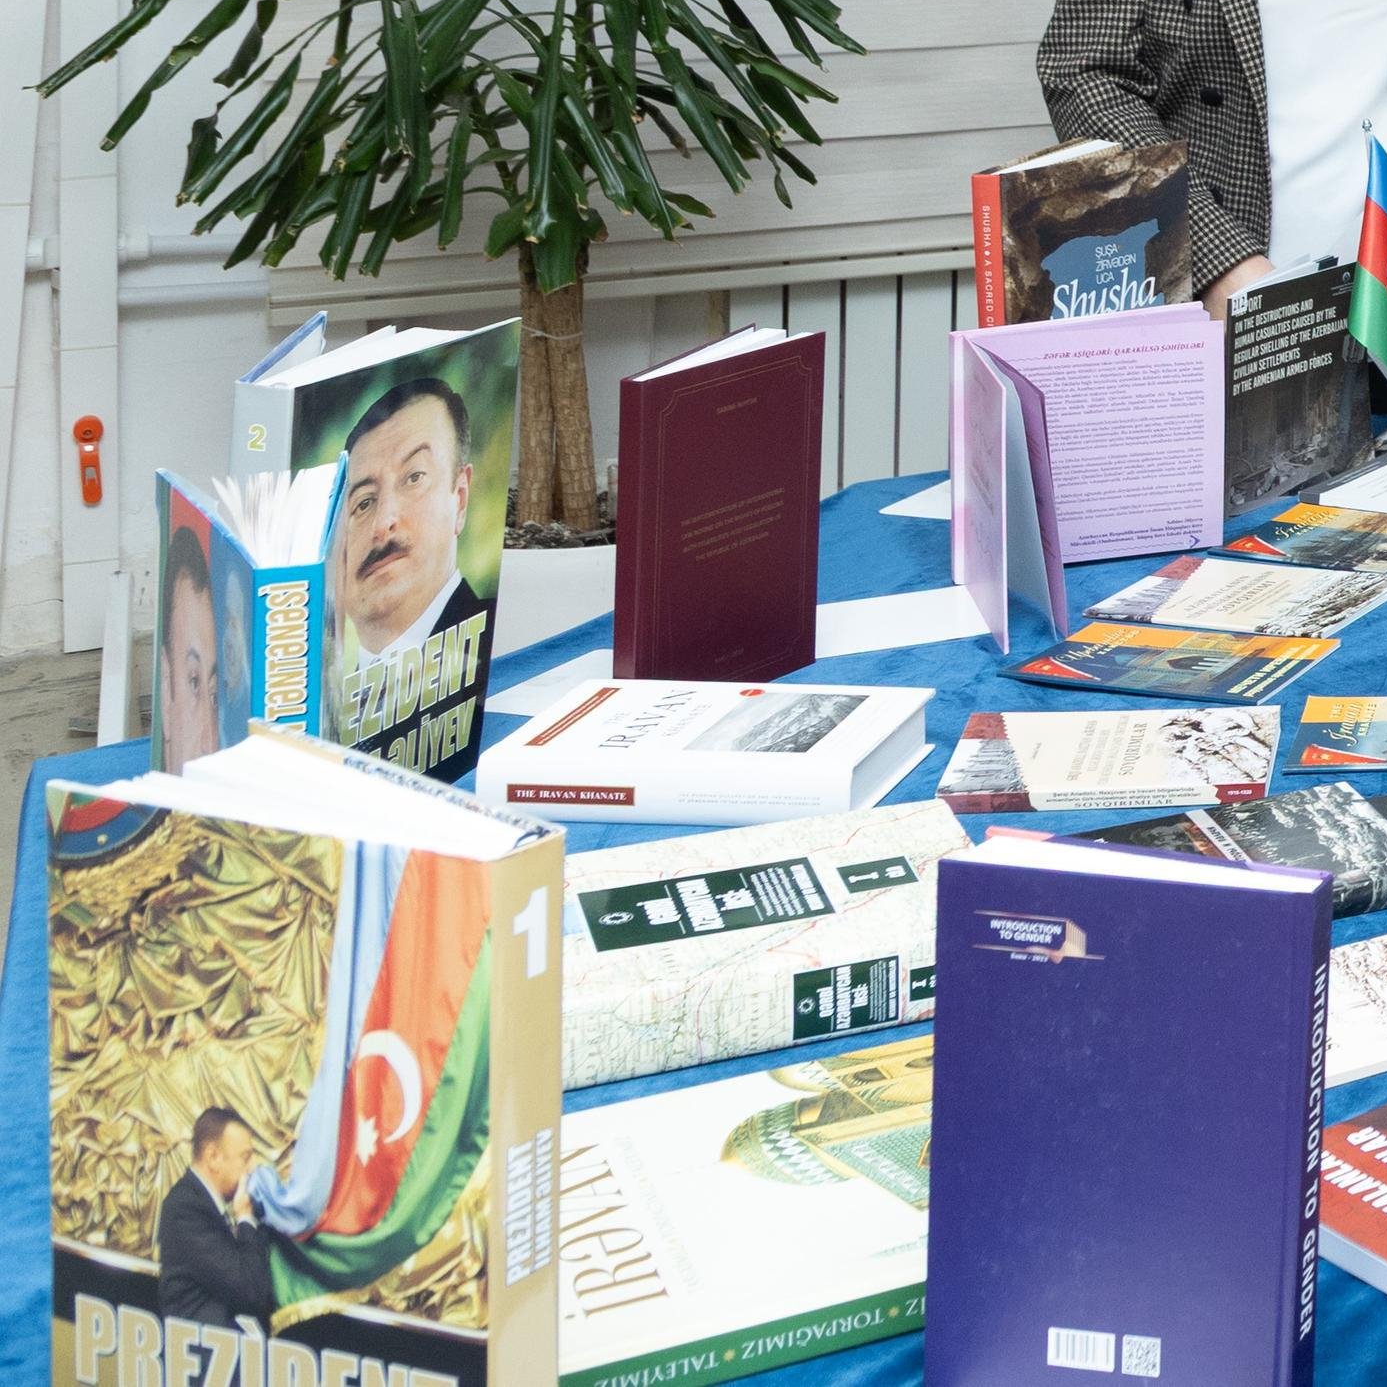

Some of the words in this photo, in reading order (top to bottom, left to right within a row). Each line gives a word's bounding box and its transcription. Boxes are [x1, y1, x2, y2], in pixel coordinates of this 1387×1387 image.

[982, 205, 992, 249] SHUSHA
[984, 270, 994, 313] SACRED
[1051, 267, 1157, 319] Shusha
[1234, 333, 1255, 349] HUMAN
[1256, 321, 1290, 342] CASUALTIES
[1292, 314, 1315, 331] CAUSED
[1316, 311, 1324, 322] BY
[1325, 306, 1337, 319] THE
[1244, 319, 1254, 331] THE
[1256, 302, 1300, 326] DESTRUCTIONS
[1301, 299, 1314, 311] AND
[1233, 361, 1258, 380] CIVILIAN
[1259, 347, 1300, 370] SETTLEMENTS
[1234, 346, 1259, 365] REGULAR
[1290, 333, 1298, 345] OF
[1299, 329, 1311, 343] THE
[1241, 380, 1252, 393] THE
[1253, 367, 1286, 388] ARMENIAN
[1286, 359, 1309, 377] ARMED
[1309, 352, 1333, 369] FORCES
[247, 424, 267, 452] 2
[341, 610, 487, 744] EZİDENT
[514, 789, 537, 800] THE
[538, 789, 577, 801] IRAVAN
[579, 790, 628, 802] KHANATE
[512, 885, 549, 980] 1
[990, 919, 1063, 935] INTRODUCTION
[999, 929, 1012, 940] TO
[1013, 932, 1053, 944] GENDER
[835, 964, 851, 1031] AZƏRBAYCAN
[1307, 962, 1327, 1174] INTRODUCTION
[1304, 1179, 1319, 1219] TO
[1300, 1227, 1317, 1341] GENDER
